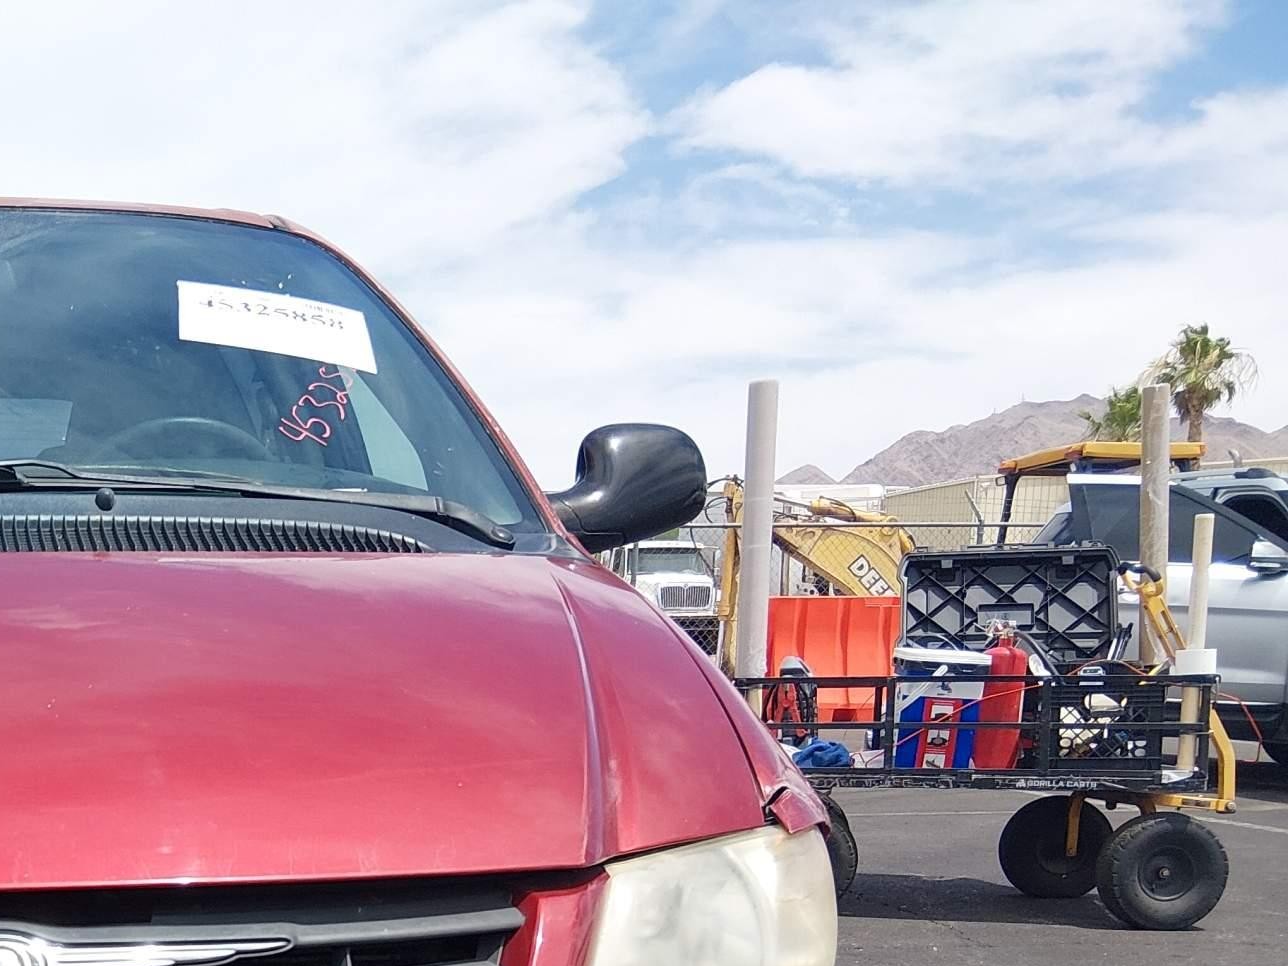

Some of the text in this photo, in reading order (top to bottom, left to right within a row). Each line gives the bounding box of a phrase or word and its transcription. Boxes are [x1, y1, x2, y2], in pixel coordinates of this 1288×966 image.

[278, 366, 356, 447] 45325
[848, 554, 898, 596] DEE
[1027, 780, 1064, 788] GORILLA
